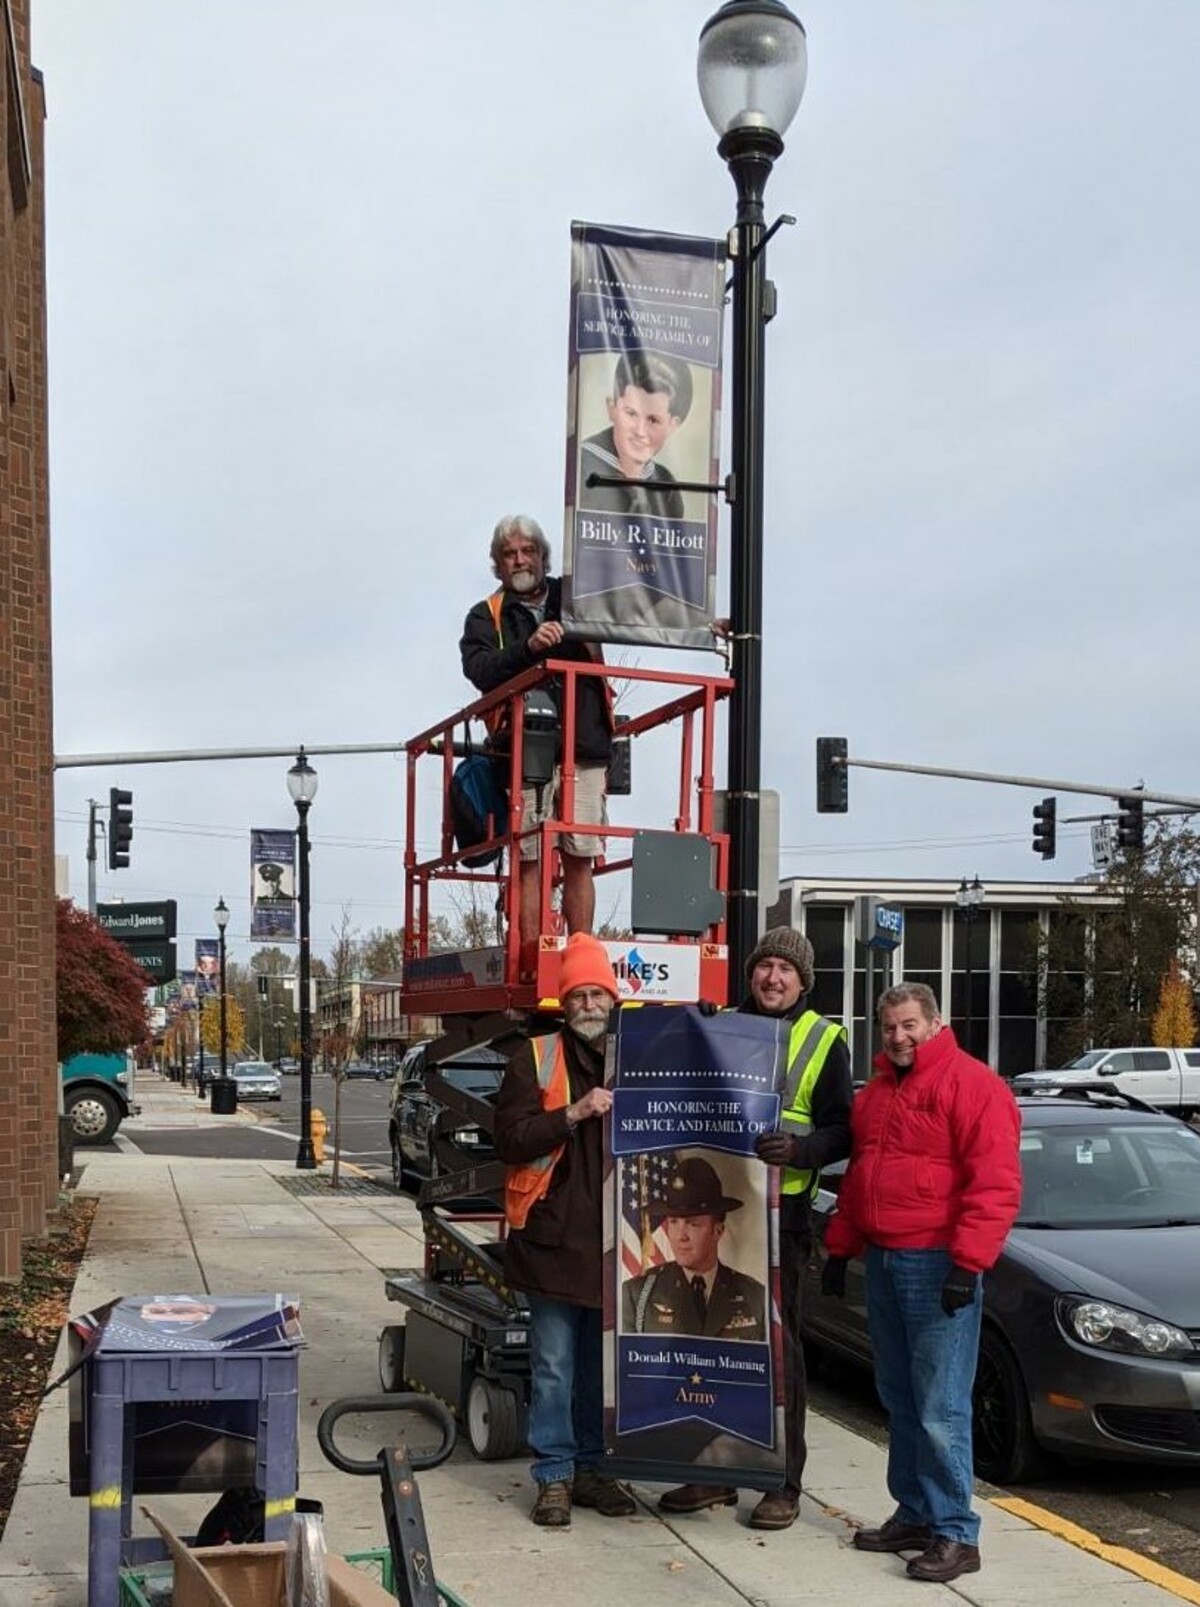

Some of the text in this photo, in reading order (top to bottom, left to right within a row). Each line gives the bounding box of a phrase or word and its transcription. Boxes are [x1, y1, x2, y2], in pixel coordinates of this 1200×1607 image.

[605, 308, 691, 329] HONORING THE
[629, 325, 654, 341] AND
[655, 328, 695, 346] FAMILY
[696, 334, 711, 347] OF
[580, 520, 705, 550] Billy R. Elliott
[1094, 827, 1109, 840] ONE
[877, 907, 901, 932] CHASE
[647, 1100, 742, 1115] HONORING THE
[620, 1118, 768, 1134] SERVICE AND FAMILY OF
[628, 1350, 766, 1373] Donald William Manning
[675, 1386, 717, 1408] Army
